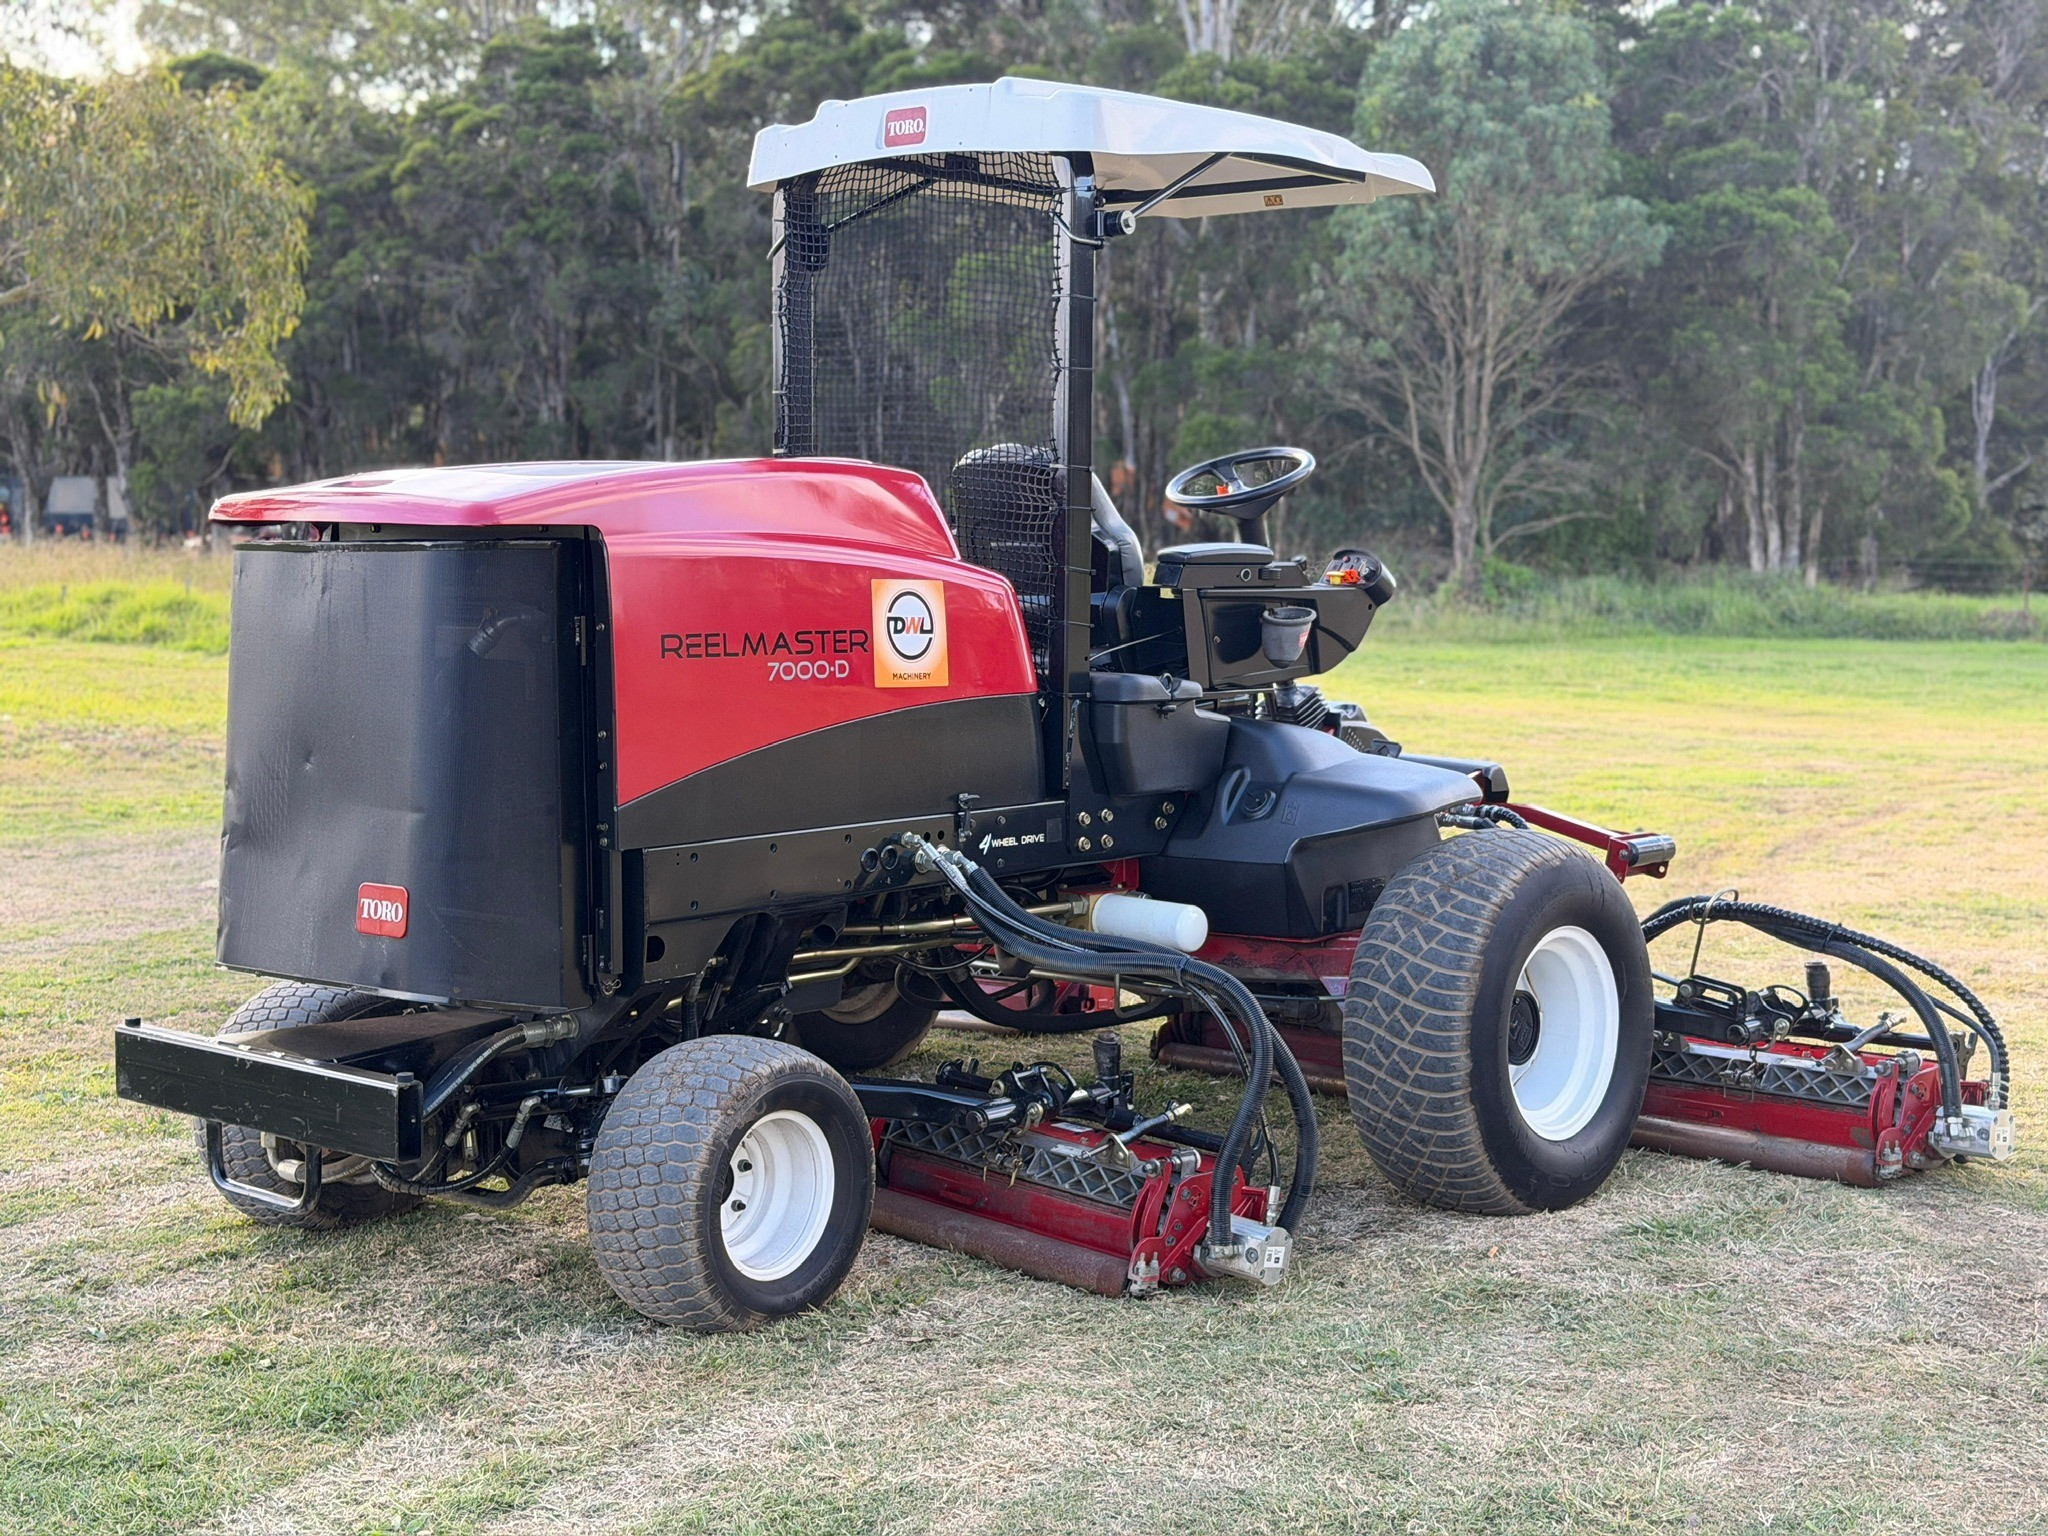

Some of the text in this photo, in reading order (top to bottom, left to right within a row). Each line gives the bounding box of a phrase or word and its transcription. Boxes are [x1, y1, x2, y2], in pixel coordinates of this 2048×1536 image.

[887, 118, 925, 136] TORO
[887, 616, 933, 635] DWL
[660, 629, 869, 659] REELMASTER
[892, 672, 931, 681] MACHINERY
[979, 832, 1045, 855] 4 WHEEL DRIVE
[360, 897, 403, 923] TORO
